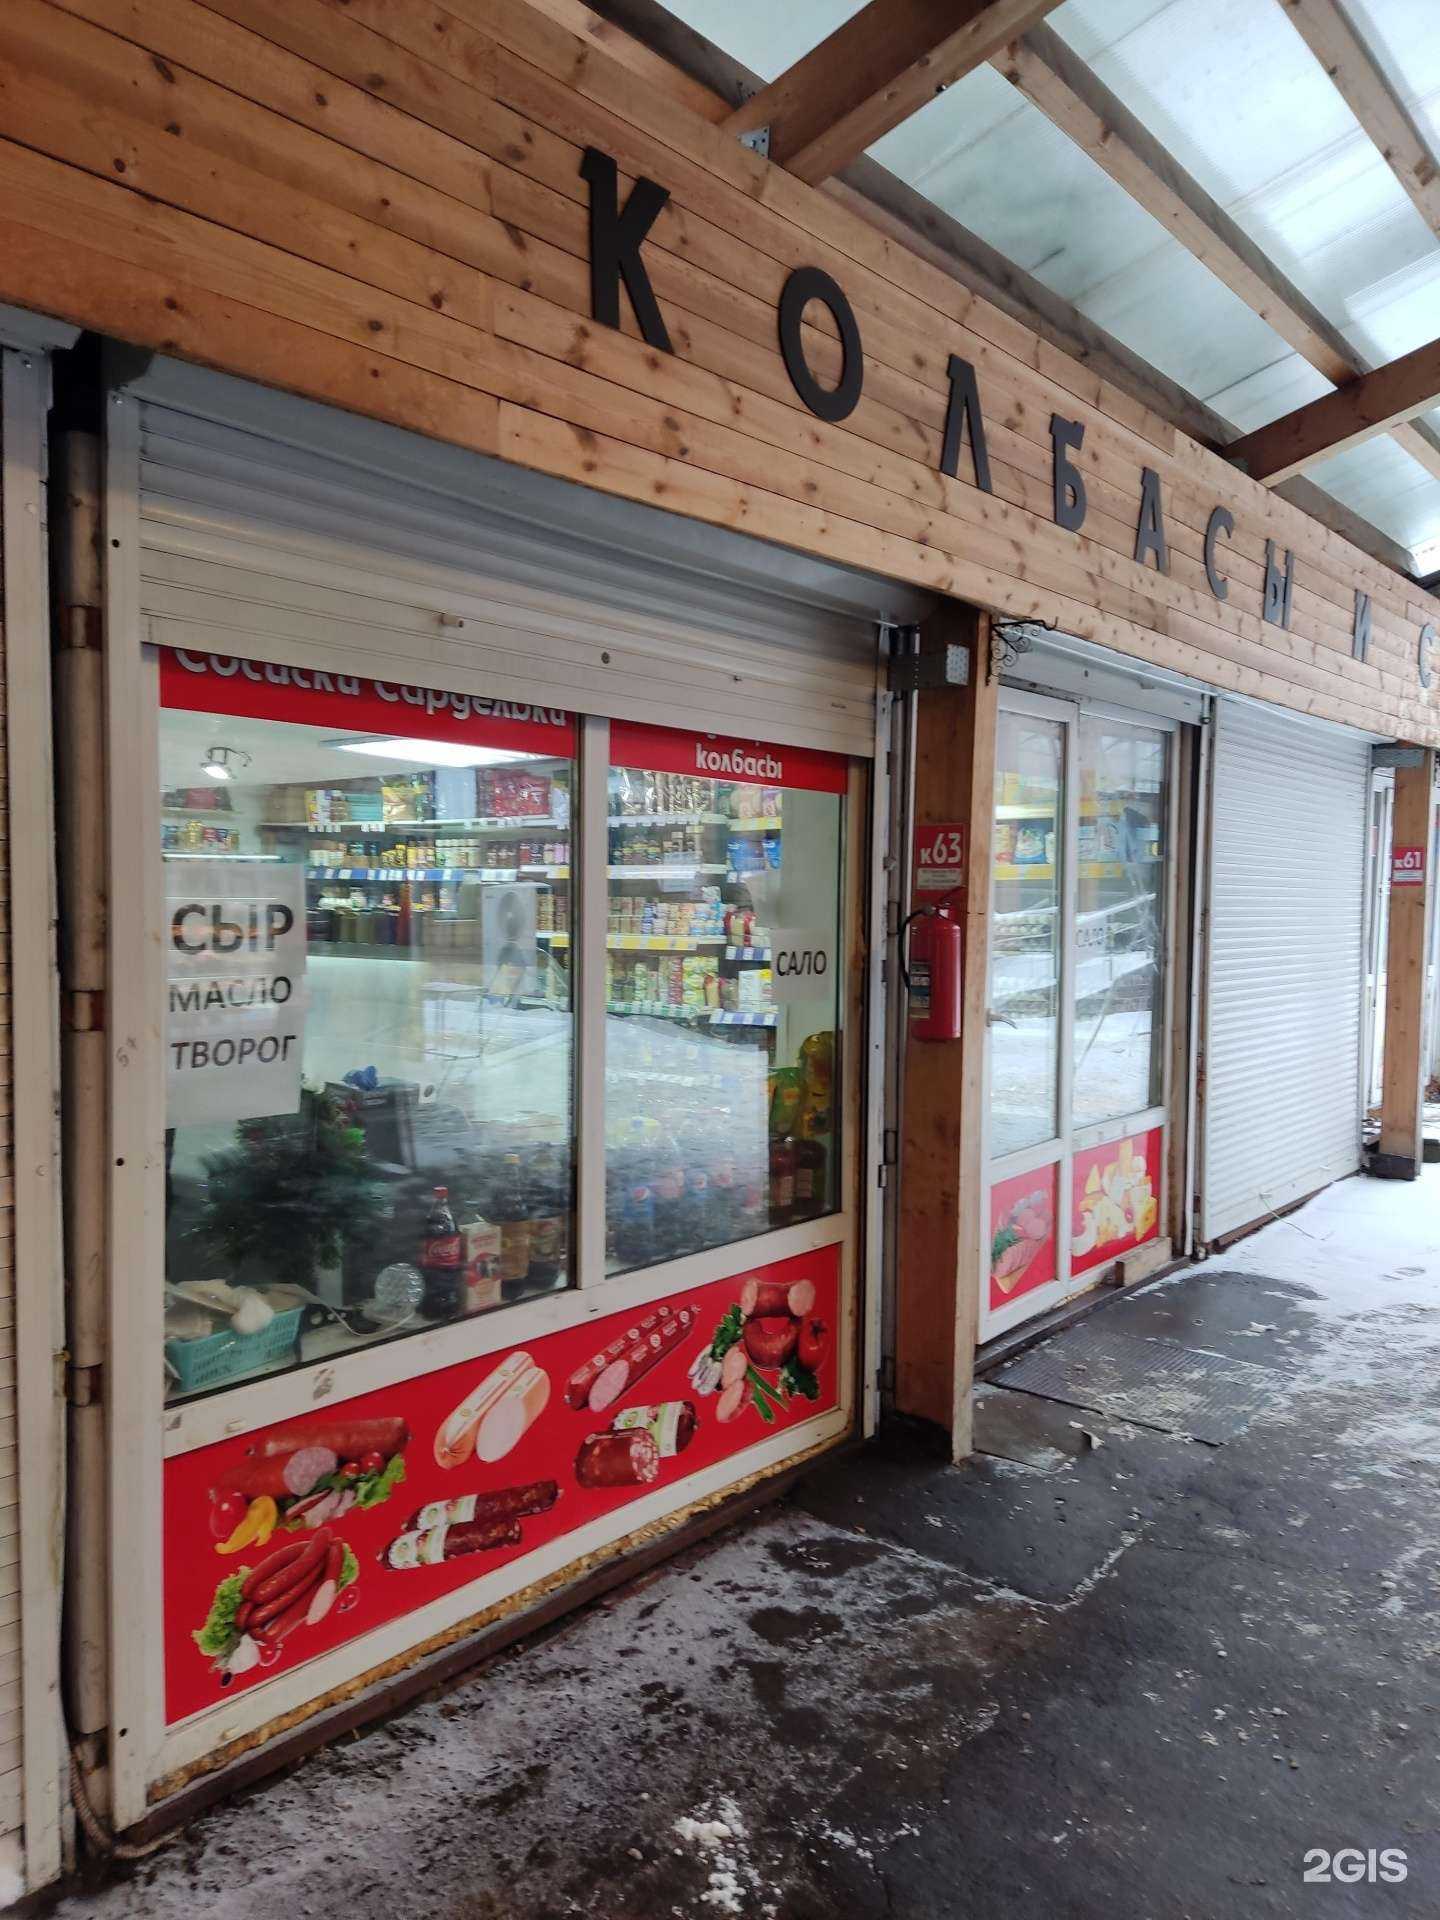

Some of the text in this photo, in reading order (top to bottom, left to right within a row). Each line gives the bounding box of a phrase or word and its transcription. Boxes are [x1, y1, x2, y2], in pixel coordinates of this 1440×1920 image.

[579, 146, 1295, 630] КОЛБАСЫ
[1354, 588, 1373, 662] И
[172, 904, 294, 954] СЫР
[776, 950, 828, 976] САЛО
[169, 976, 292, 1012] МАСЛО
[171, 1035, 297, 1069] ТВОРОГ
